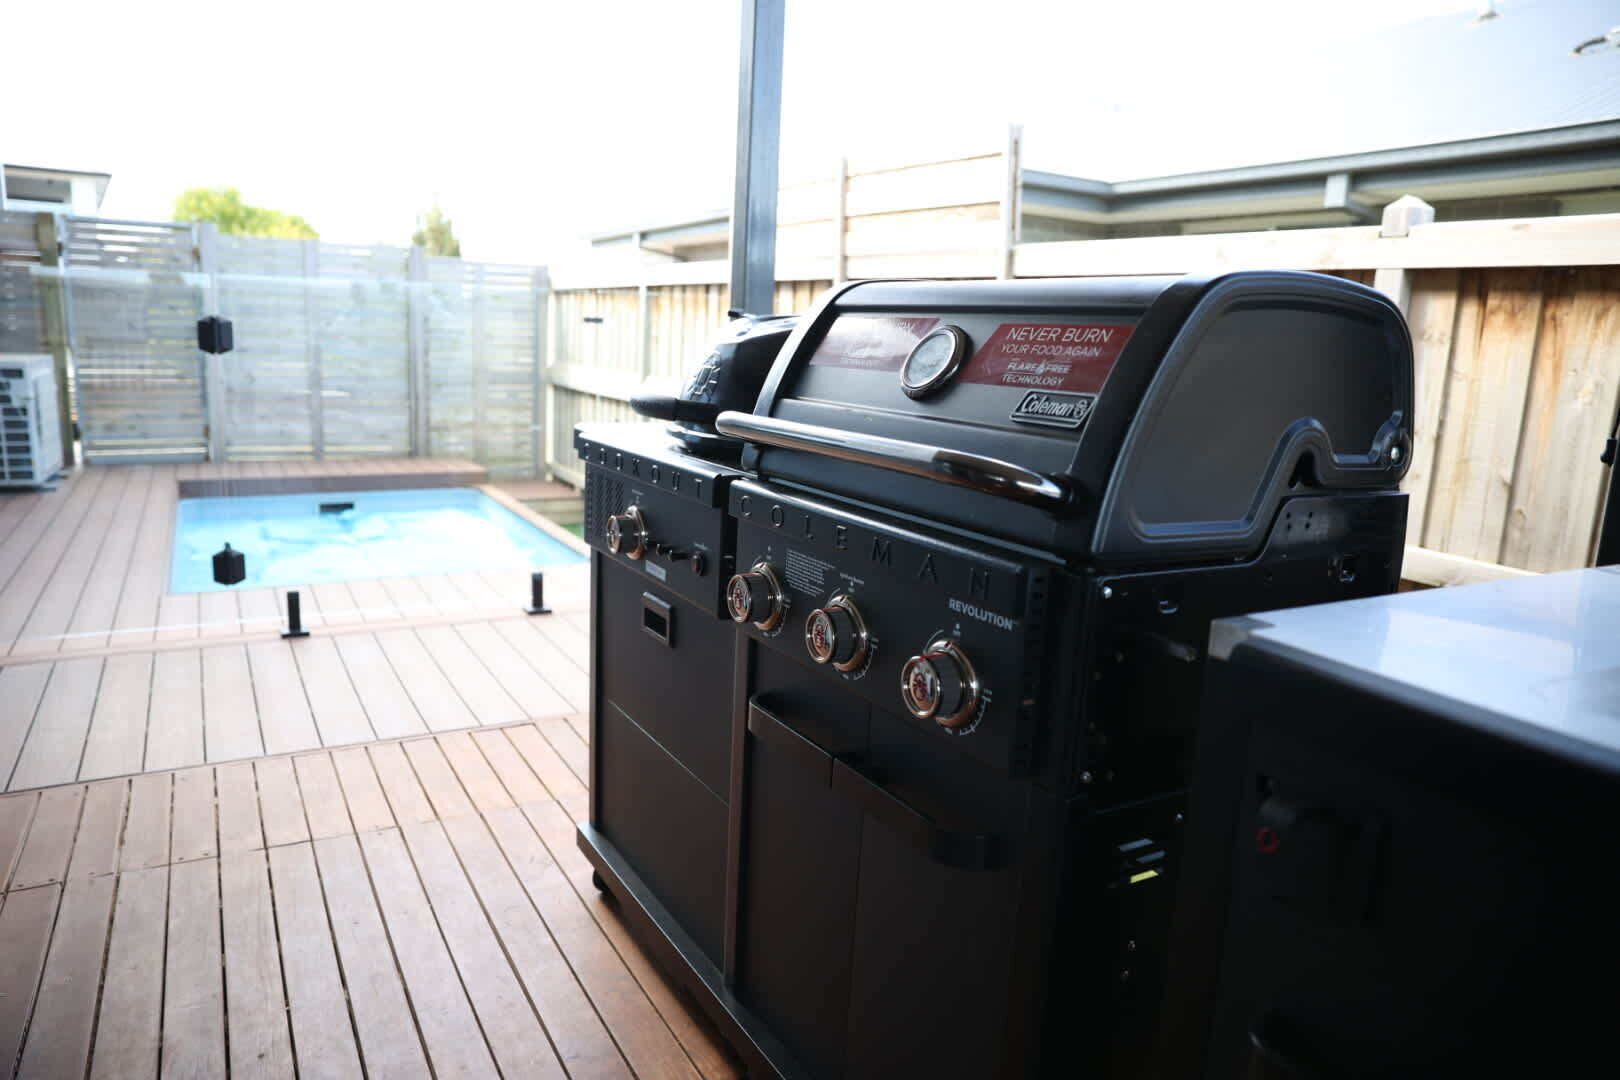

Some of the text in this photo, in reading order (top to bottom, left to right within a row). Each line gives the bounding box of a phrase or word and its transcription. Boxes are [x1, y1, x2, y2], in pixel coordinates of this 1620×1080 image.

[1006, 327, 1113, 343] NEVER BURN
[1001, 344, 1102, 358] YOUR FOOD AGAIN
[1002, 374, 1065, 385] TECHNOLOGY
[1021, 393, 1076, 417] Coleman
[739, 495, 990, 600] COLEMAN
